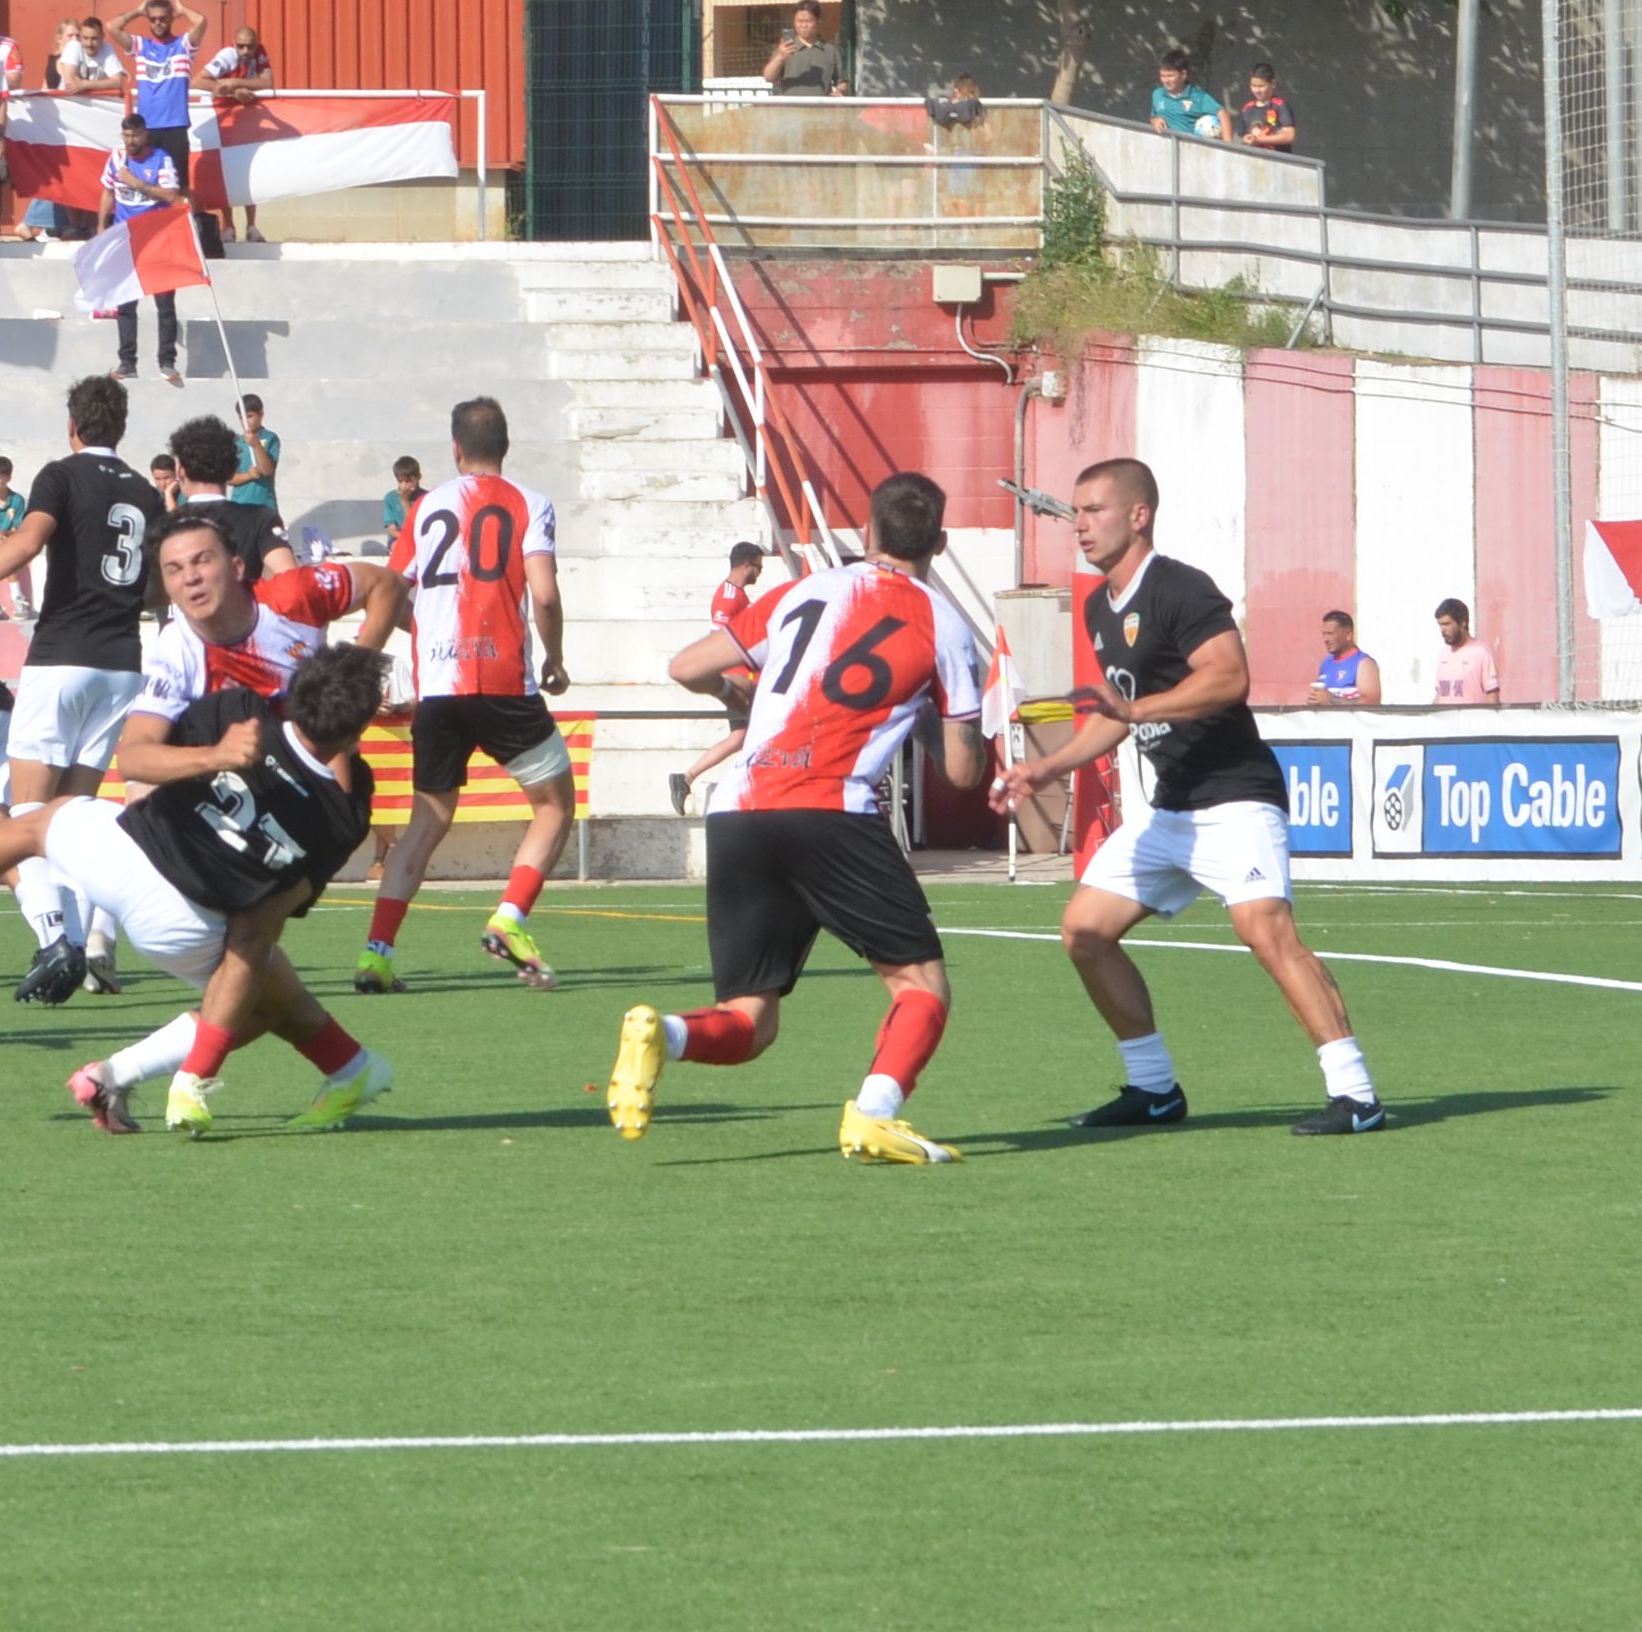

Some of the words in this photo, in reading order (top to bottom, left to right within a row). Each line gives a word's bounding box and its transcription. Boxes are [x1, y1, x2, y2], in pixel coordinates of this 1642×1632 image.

[100, 502, 147, 586] 3
[420, 503, 514, 590] 20
[770, 598, 908, 711] 16
[1289, 766, 1340, 828] ble
[1433, 765, 1491, 843] Top
[1502, 762, 1606, 828] Cable
